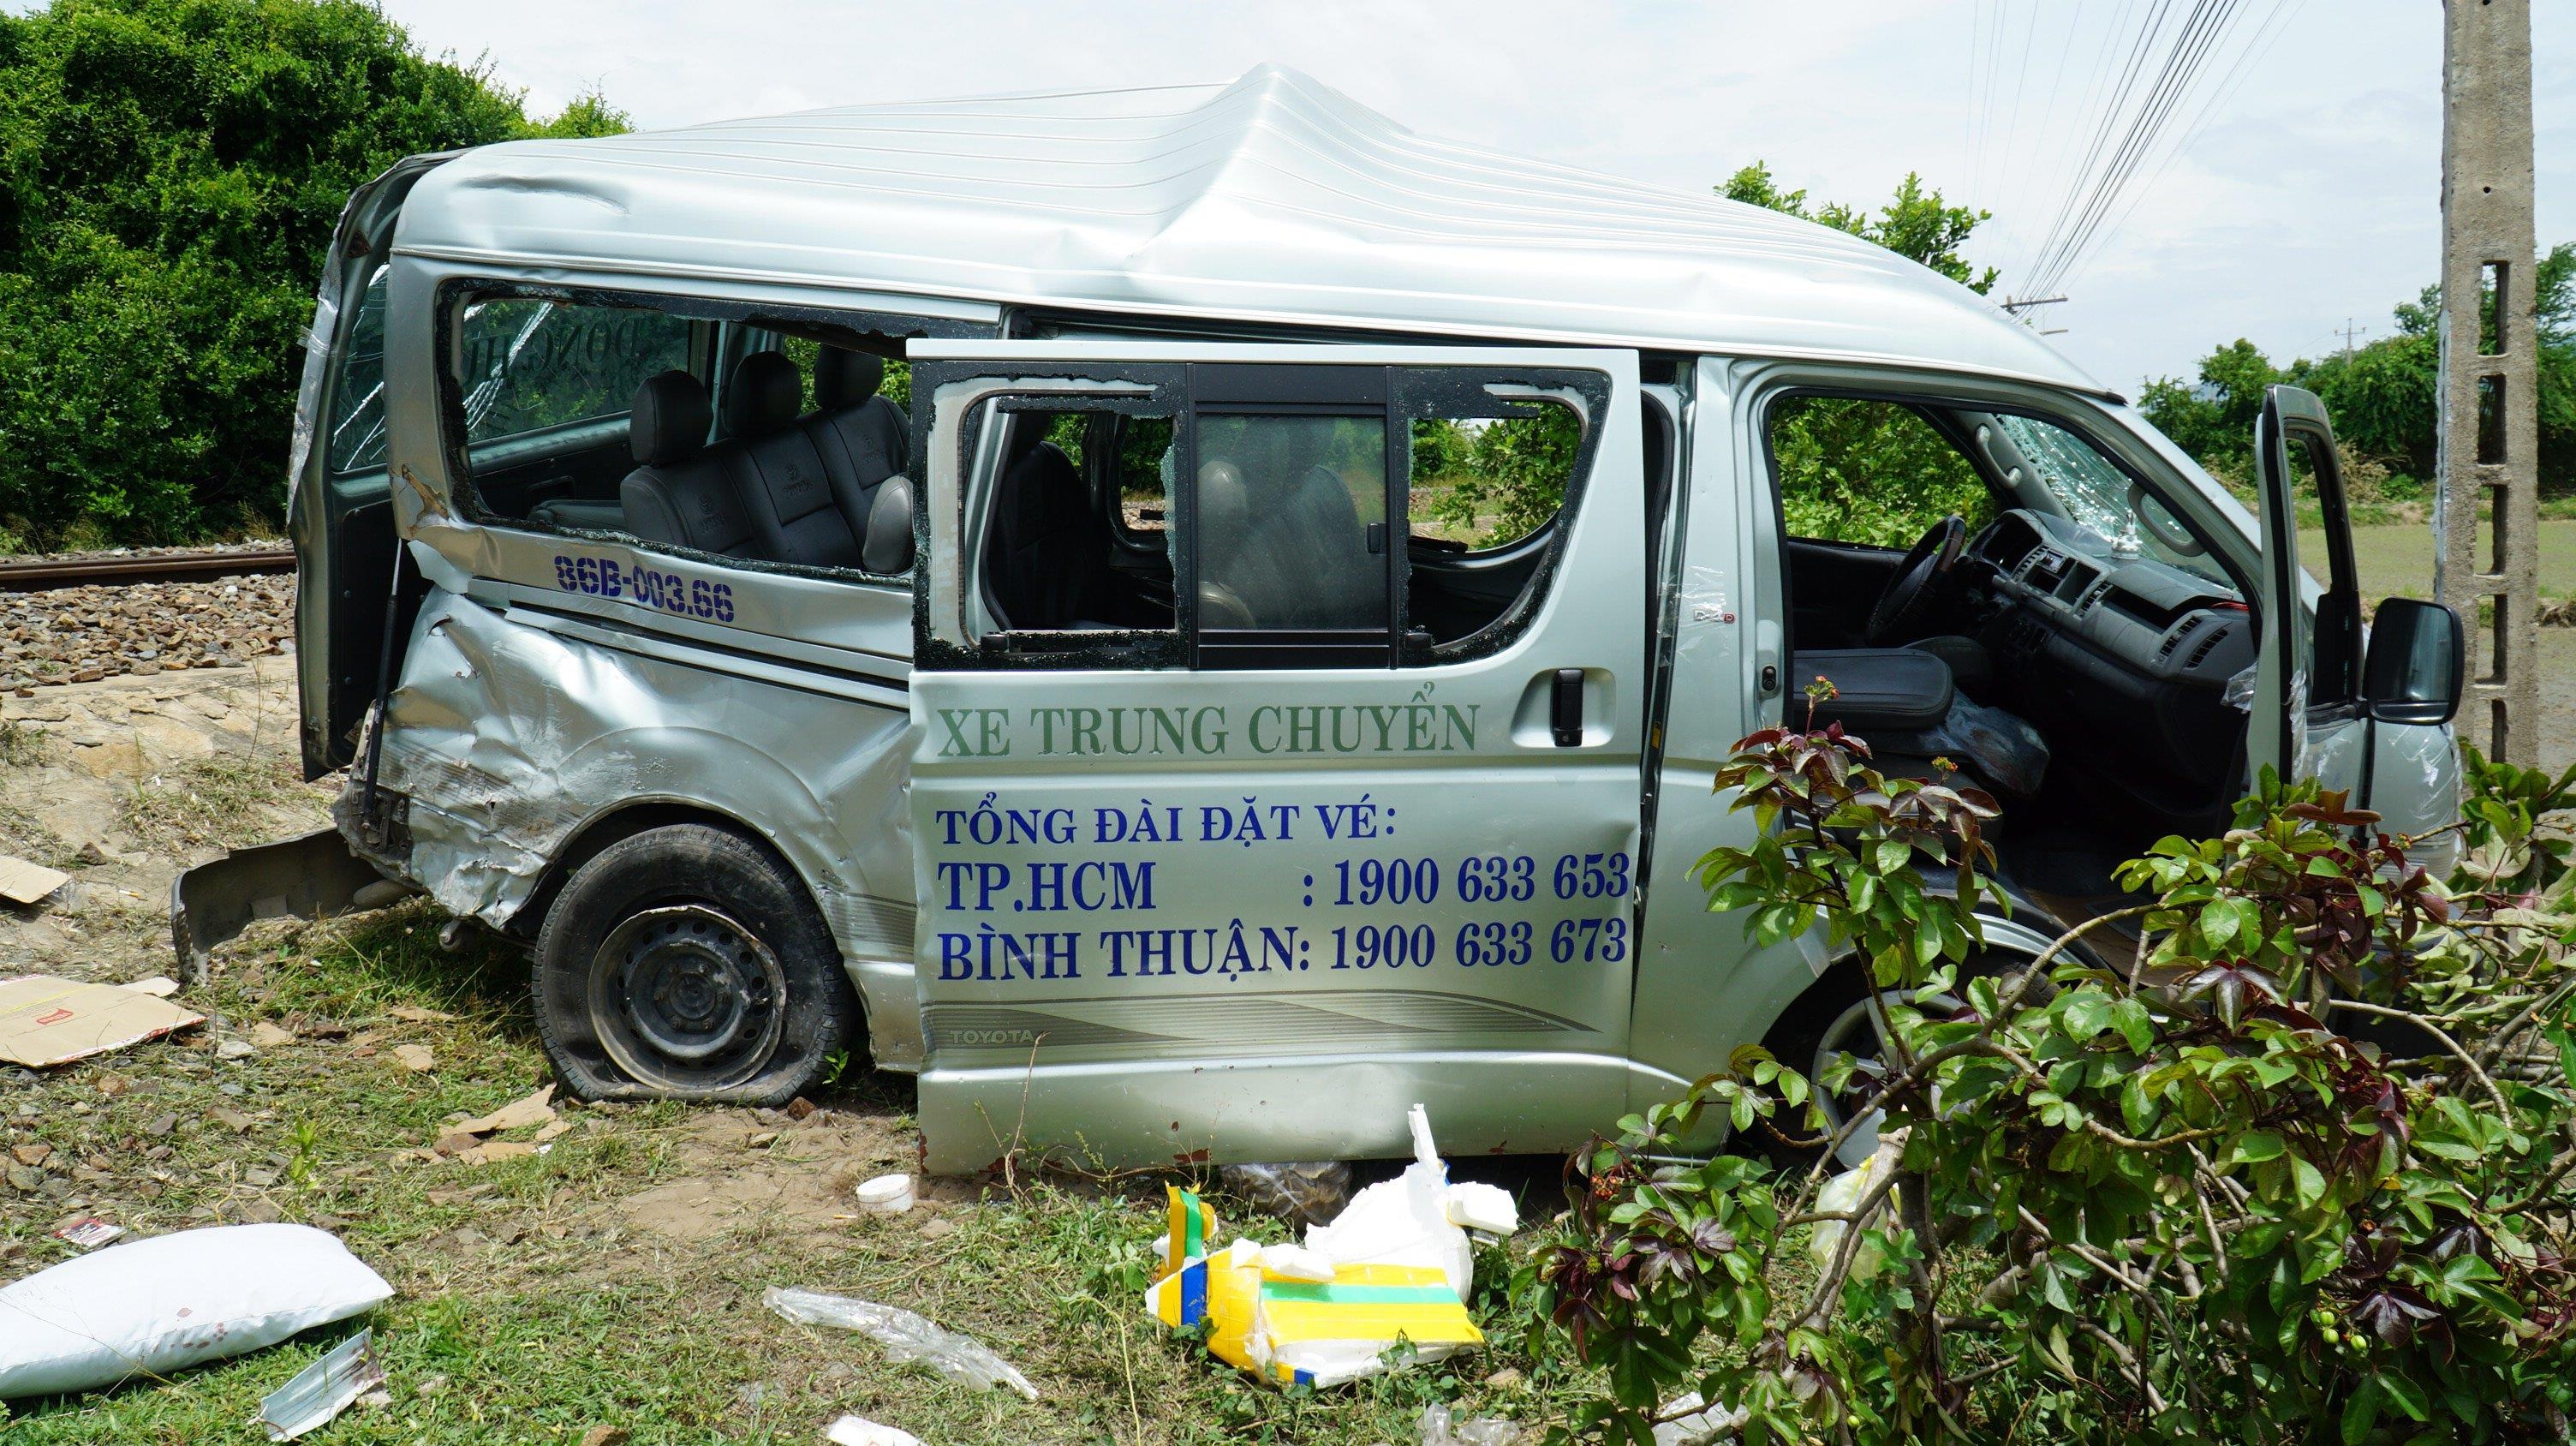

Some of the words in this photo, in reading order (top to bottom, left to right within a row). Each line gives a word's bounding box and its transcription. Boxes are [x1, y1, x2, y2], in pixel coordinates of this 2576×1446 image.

[554, 555, 735, 623] 86B-003.66
[937, 708, 1011, 757] XE
[1030, 707, 1230, 756] TRUNG
[1248, 681, 1482, 754] CHUYỂN
[936, 792, 1077, 845] TỔNG
[1094, 798, 1184, 843] ĐÀI
[1199, 796, 1300, 847] ĐẶT
[1314, 793, 1396, 839] VÉ:
[938, 861, 1156, 911] TP.HCM
[1333, 857, 1440, 906] 1900
[1457, 855, 1536, 902] 633
[1553, 852, 1631, 899] 653
[937, 922, 1082, 981] BÌNH
[1100, 917, 1310, 983] THUẬN:
[1330, 924, 1437, 970] 1900
[1455, 922, 1533, 966] 633
[1550, 917, 1627, 963] 673
[950, 1029, 1035, 1044] TOYOTA
